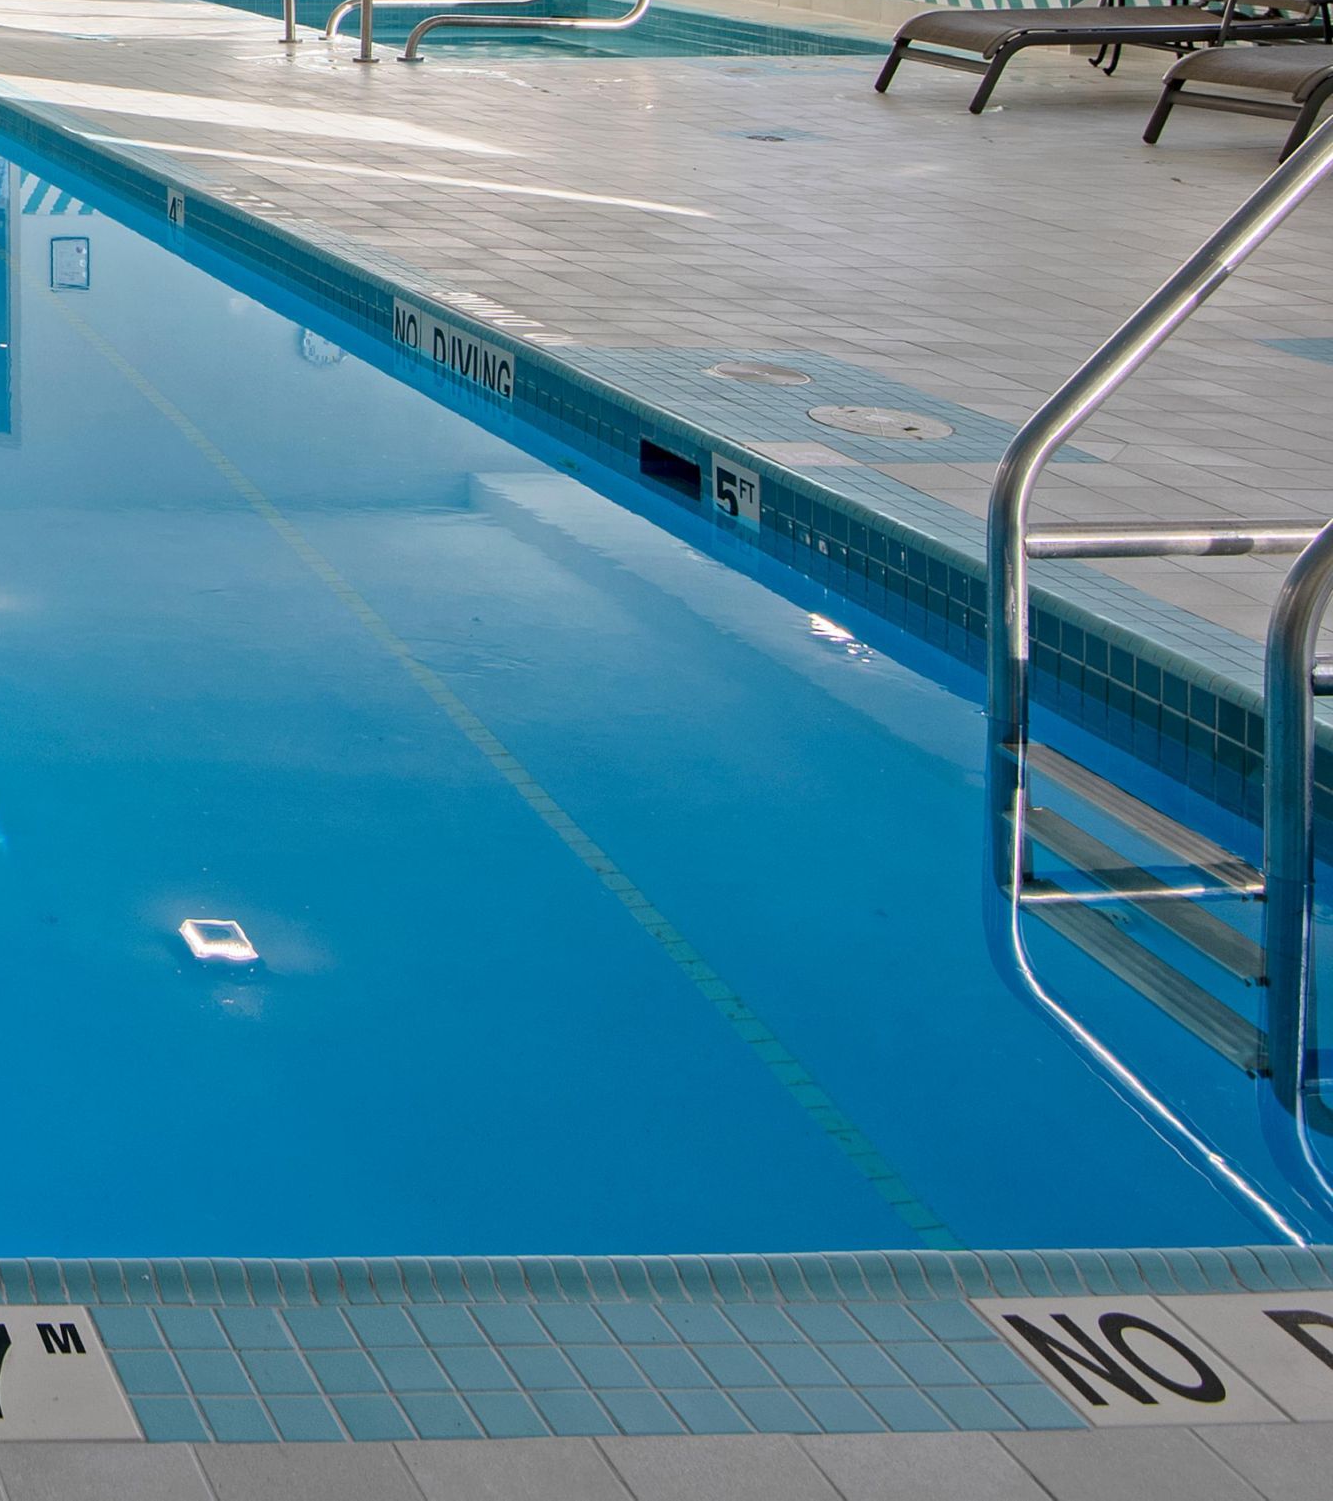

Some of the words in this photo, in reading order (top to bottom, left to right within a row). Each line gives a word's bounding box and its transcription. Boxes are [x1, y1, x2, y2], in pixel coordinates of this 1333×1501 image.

[395, 306, 418, 349] NO
[433, 327, 511, 398] DIVING
[716, 466, 739, 517] 5
[740, 478, 755, 504] FT
[36, 1323, 86, 1354] M
[1003, 1311, 1227, 1408] NO
